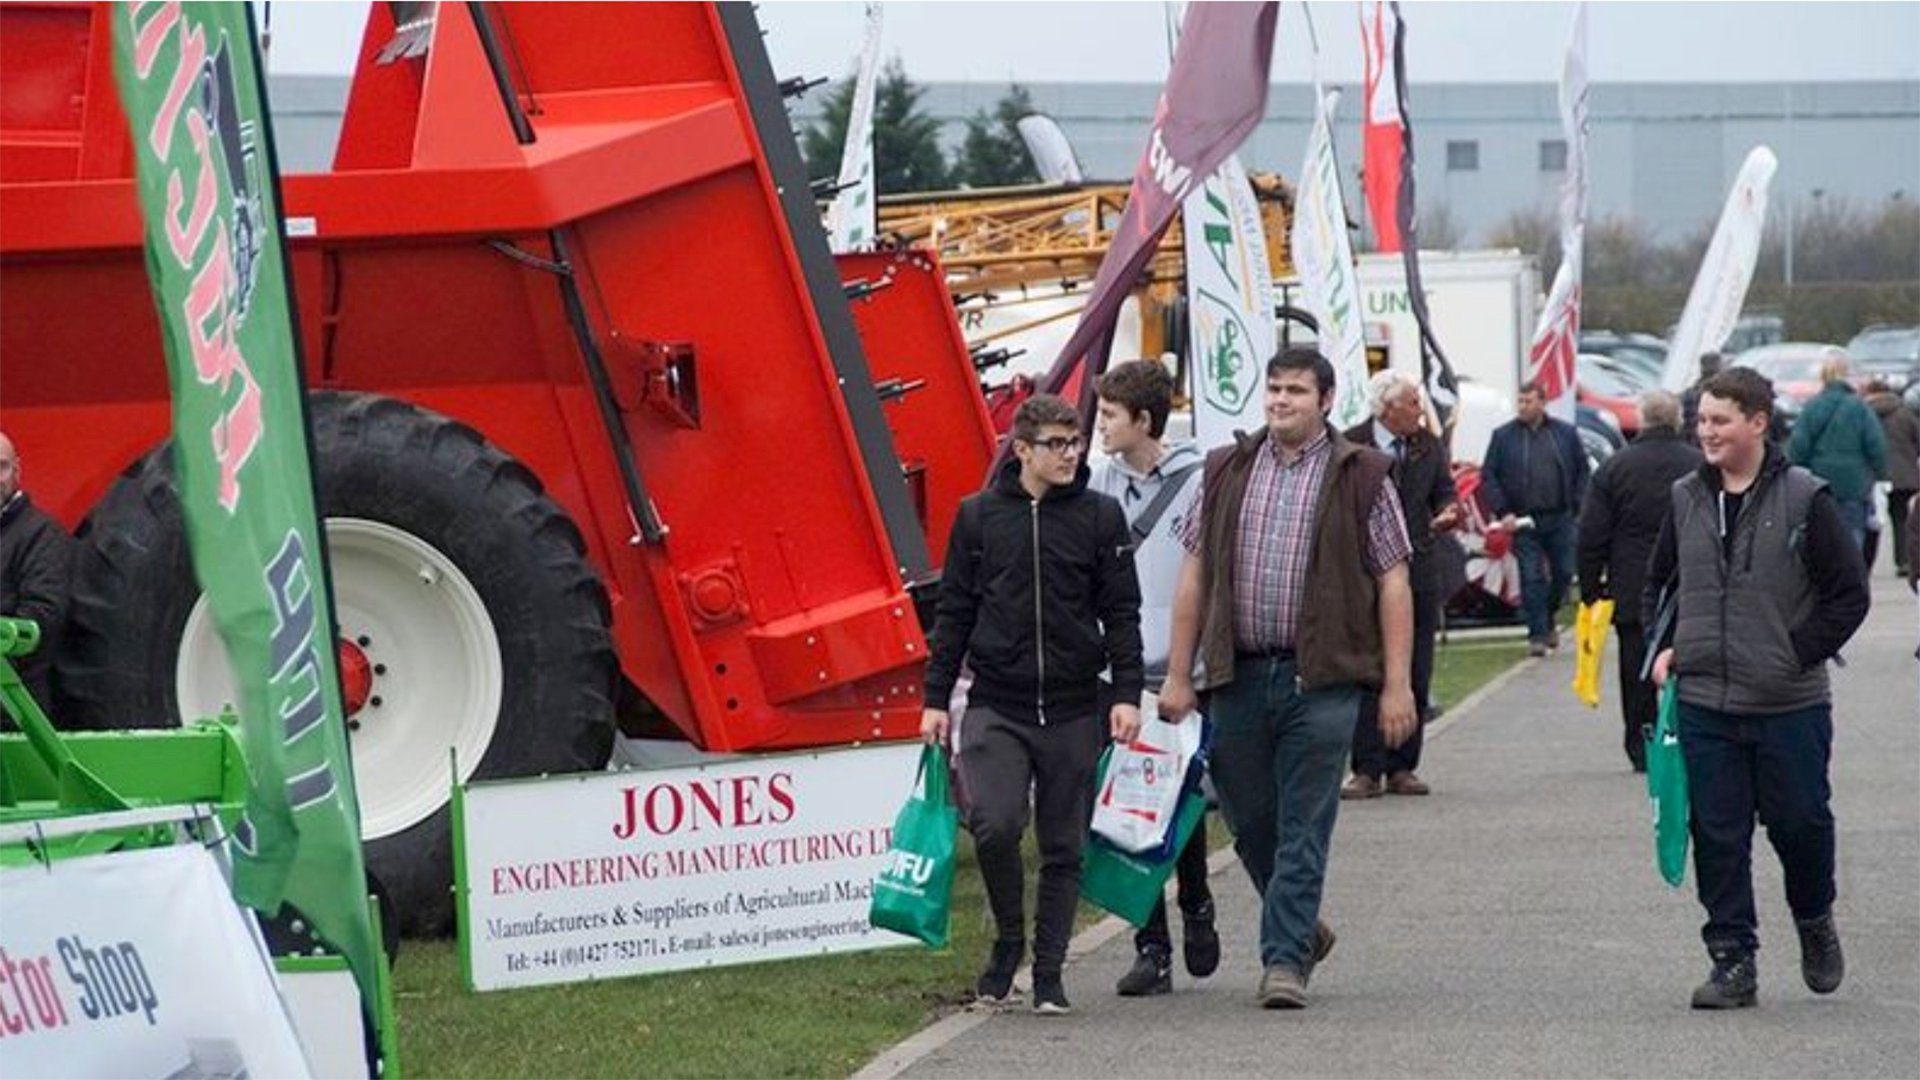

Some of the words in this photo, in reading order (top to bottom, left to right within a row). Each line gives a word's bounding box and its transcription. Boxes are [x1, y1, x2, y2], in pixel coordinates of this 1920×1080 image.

[612, 772, 795, 840] JONES
[492, 850, 659, 895] ENGINEERING
[666, 828, 863, 878] MANUFACTURING
[486, 913, 607, 941] Manufacturers
[612, 904, 628, 927] &
[632, 898, 710, 928] Suppliers
[713, 892, 732, 916] of
[734, 884, 831, 920] Agricultural
[56, 934, 159, 1026] Shop
